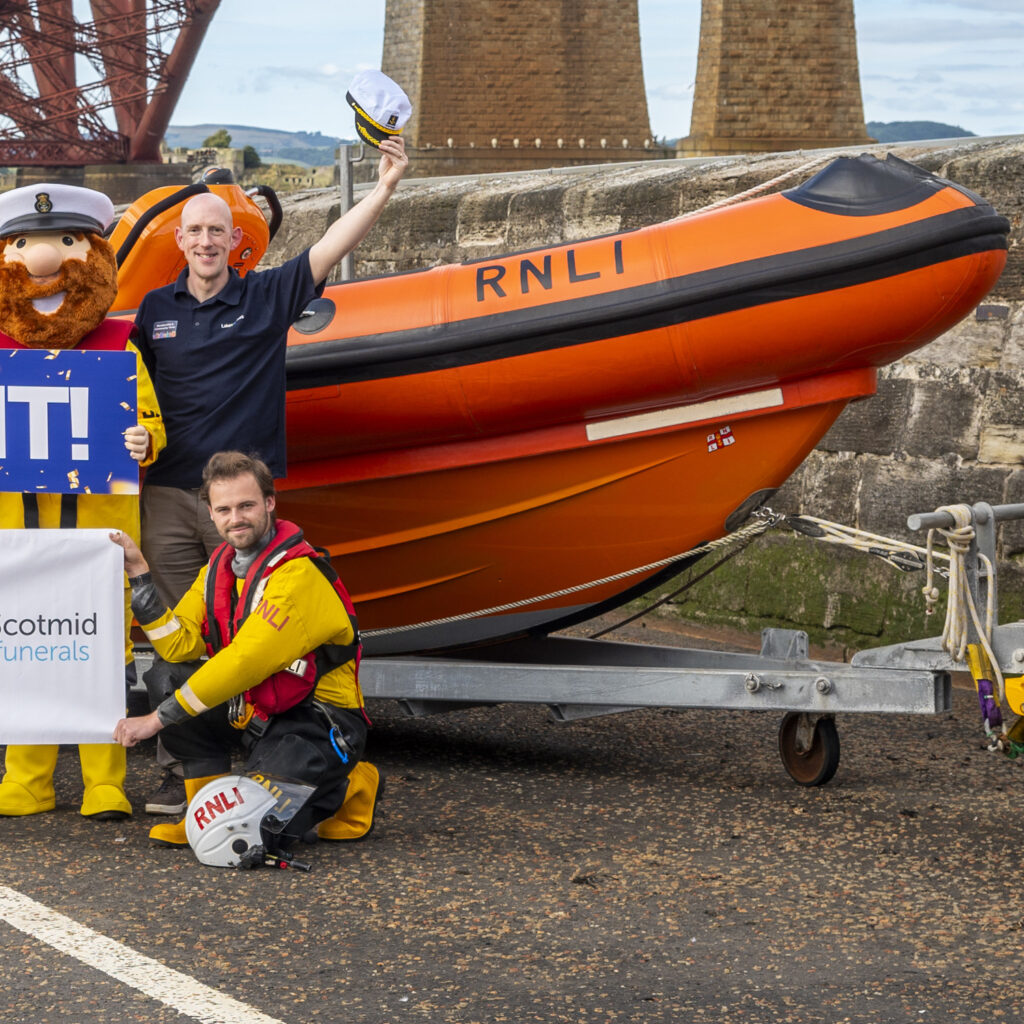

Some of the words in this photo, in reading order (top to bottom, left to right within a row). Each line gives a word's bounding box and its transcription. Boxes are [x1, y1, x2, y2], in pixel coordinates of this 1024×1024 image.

[476, 240, 624, 302] RNLI
[256, 599, 290, 632] NLI
[194, 787, 245, 830] RNLI
